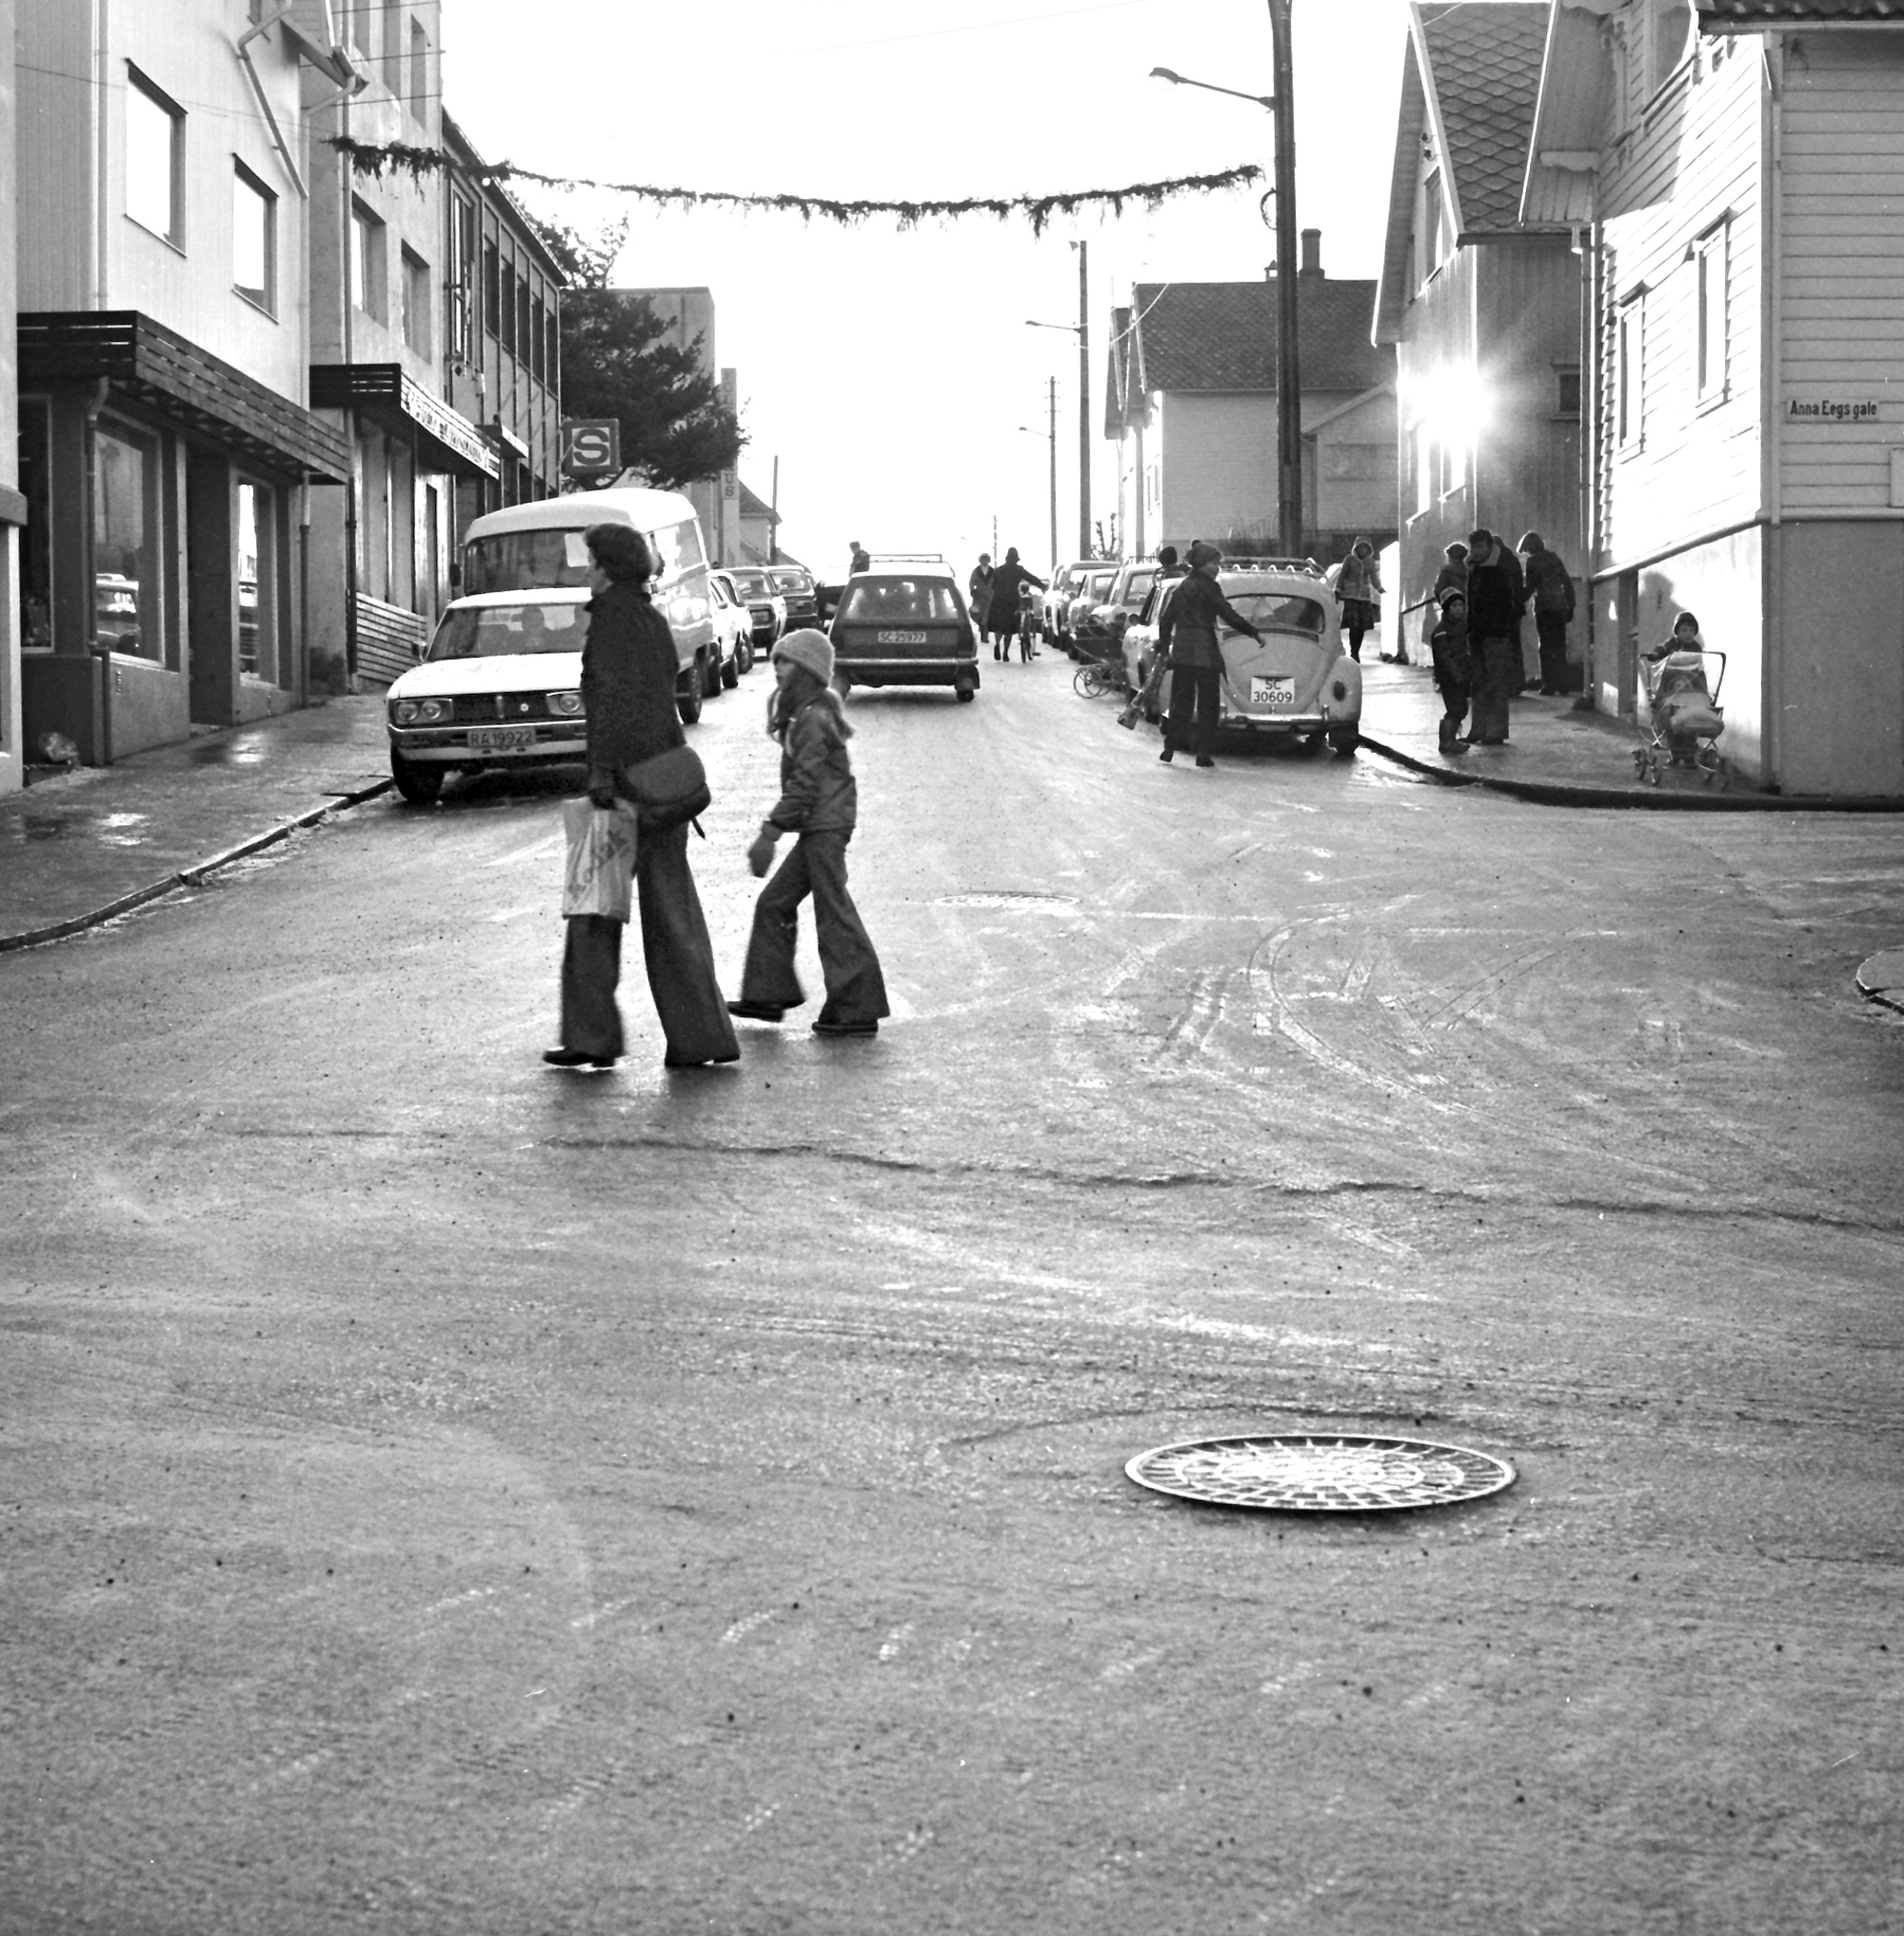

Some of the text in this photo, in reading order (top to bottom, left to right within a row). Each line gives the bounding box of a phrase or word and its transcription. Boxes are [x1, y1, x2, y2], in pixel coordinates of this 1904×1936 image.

[1790, 400, 1819, 416] Anna
[1822, 400, 1851, 420] Eegs
[573, 427, 610, 465] S
[1264, 678, 1282, 690] SC
[1253, 691, 1293, 702] 30609
